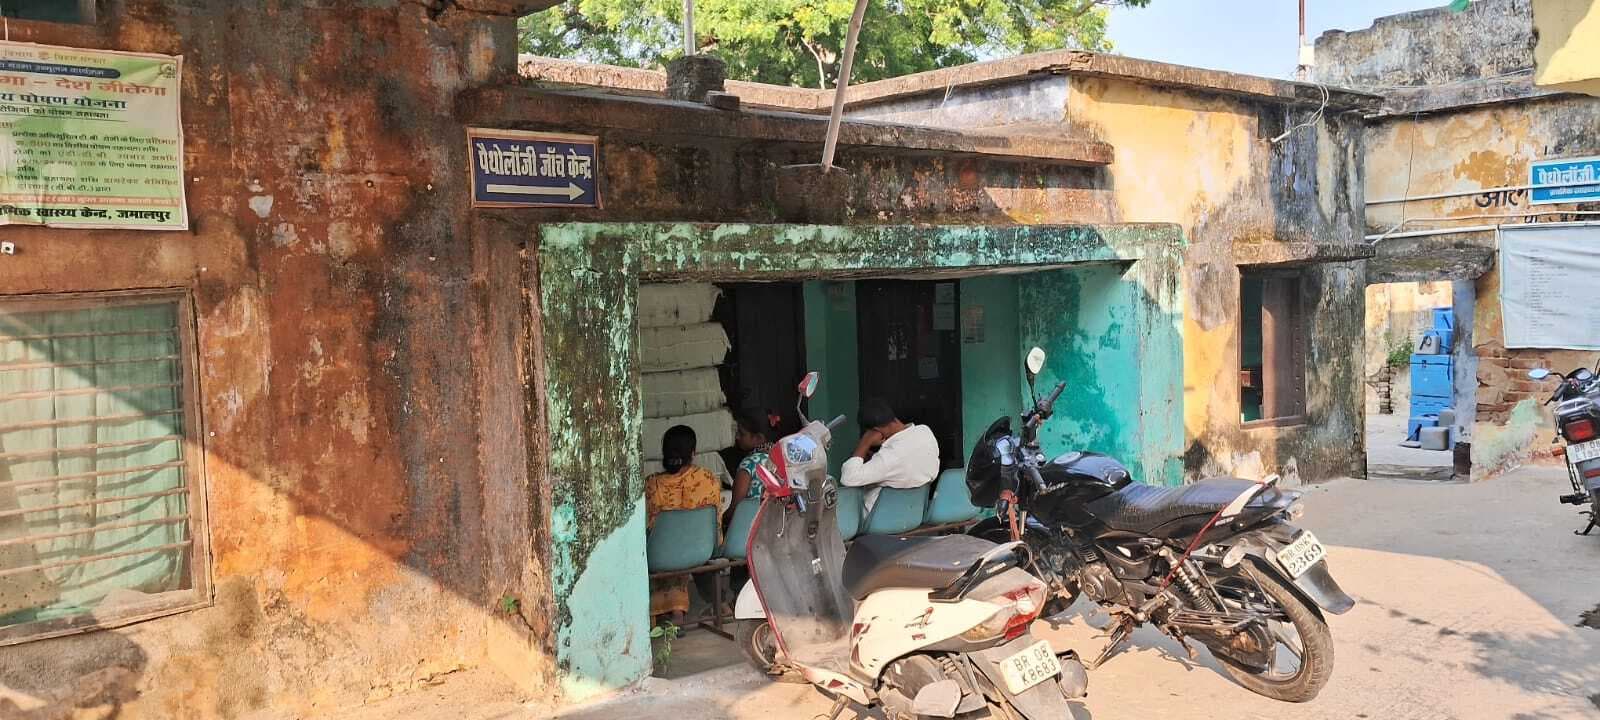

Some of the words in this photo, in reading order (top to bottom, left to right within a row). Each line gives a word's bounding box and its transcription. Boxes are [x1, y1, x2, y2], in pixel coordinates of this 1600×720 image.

[0, 75, 26, 86] गा
[56, 78, 91, 91] देश
[98, 82, 167, 96] जीतेगा
[0, 92, 13, 101] य
[20, 92, 68, 105] पोषण
[73, 96, 127, 109] योजना
[476, 142, 538, 177] पैथोलॉजी
[567, 148, 592, 180] केन्द्र
[1537, 165, 1595, 186] पैथोलॉजी
[116, 209, 171, 223] जमालपुर
[1289, 543, 1322, 573] 2369
[1013, 655, 1030, 671] BR
[1033, 646, 1049, 660] 08
[1022, 658, 1056, 685] K8683
